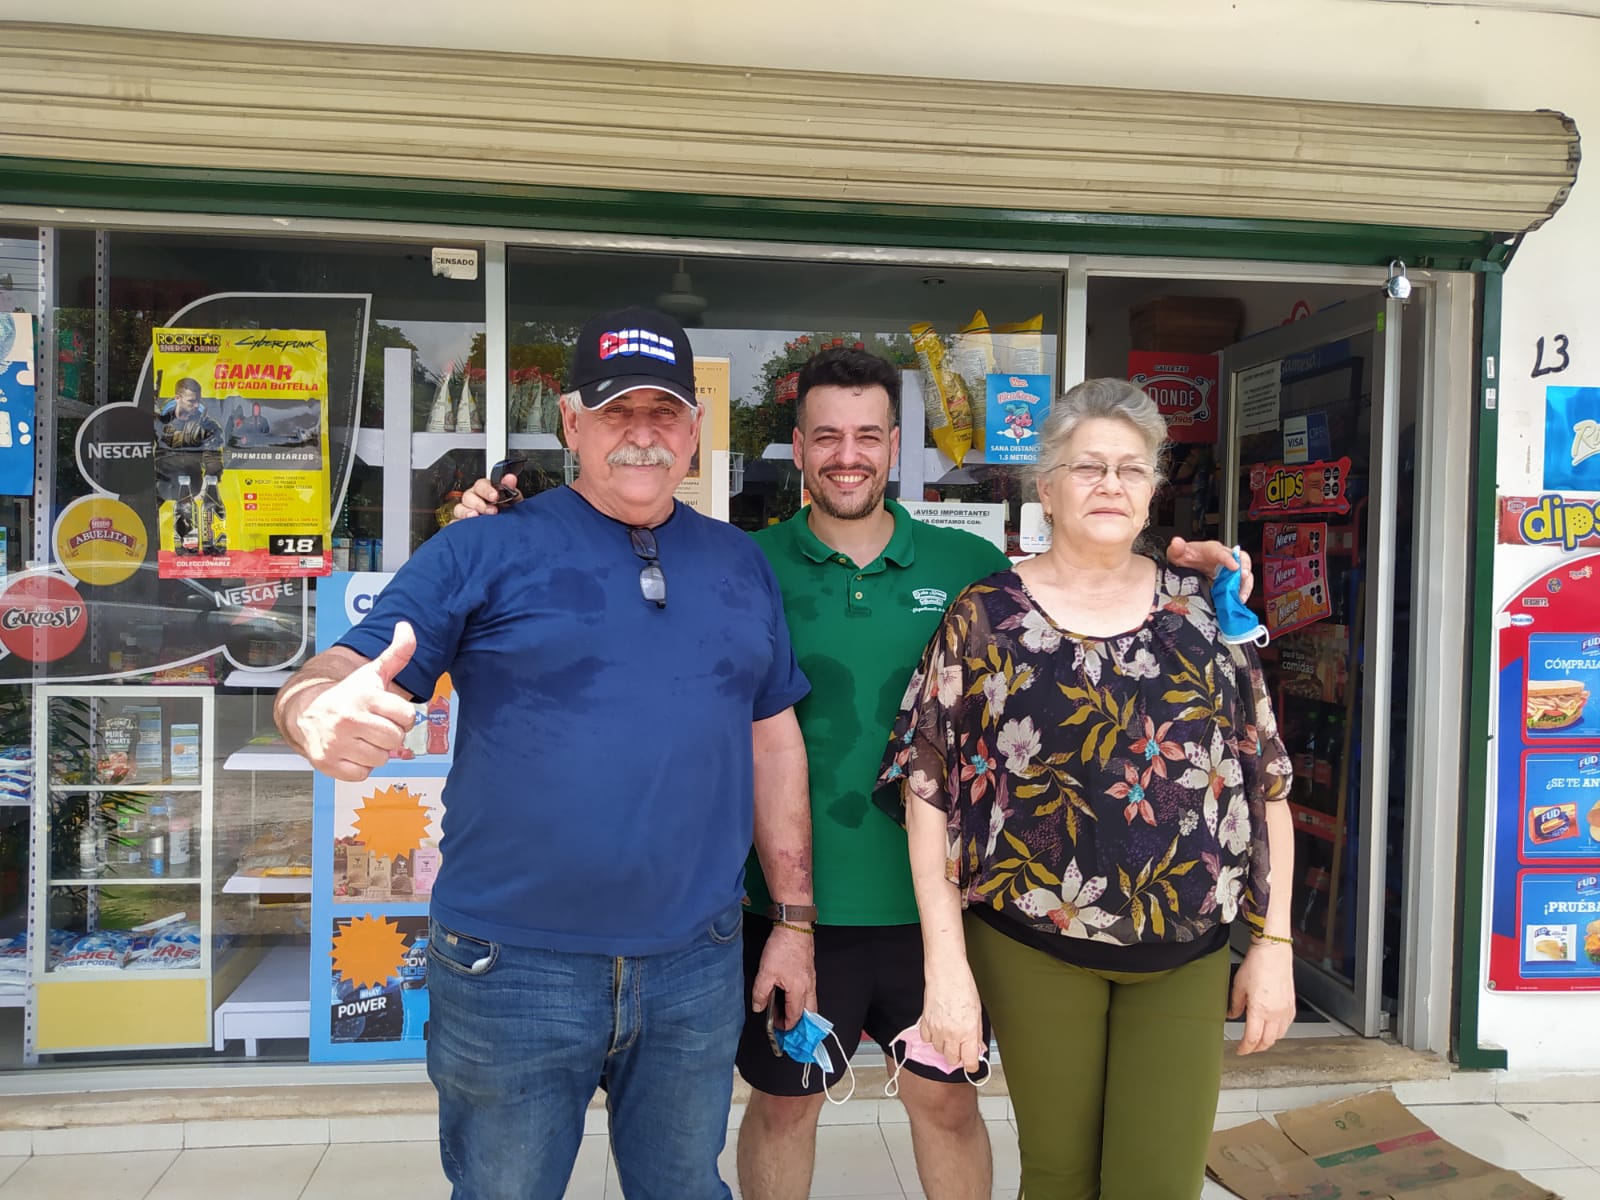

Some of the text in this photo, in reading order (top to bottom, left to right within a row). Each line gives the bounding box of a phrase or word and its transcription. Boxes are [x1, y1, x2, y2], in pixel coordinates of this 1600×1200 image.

[157, 333, 221, 346] ROCKSTAR
[599, 328, 677, 365] CUBA
[193, 345, 219, 353] DRINK
[1531, 333, 1571, 378] L3
[214, 363, 293, 380] GANAR
[214, 381, 318, 391] CON CADA BOTELLA
[1149, 387, 1195, 406] DONDE
[89, 442, 153, 459] NESCAF
[1288, 438, 1304, 448] VISA
[1266, 470, 1304, 507] dips
[76, 529, 129, 545] ABUELITA
[1276, 531, 1297, 548] Nieve
[277, 538, 314, 553] $18
[1275, 567, 1297, 585] Nieve
[1279, 598, 1300, 619] Nieve
[1282, 660, 1314, 674] comidas
[1580, 755, 1598, 768] FUD
[1546, 778, 1565, 790] ¿SE
[1566, 778, 1581, 788] TE
[1541, 808, 1561, 823] FUD
[1577, 876, 1597, 889] FUD
[338, 996, 387, 1018] POWER
